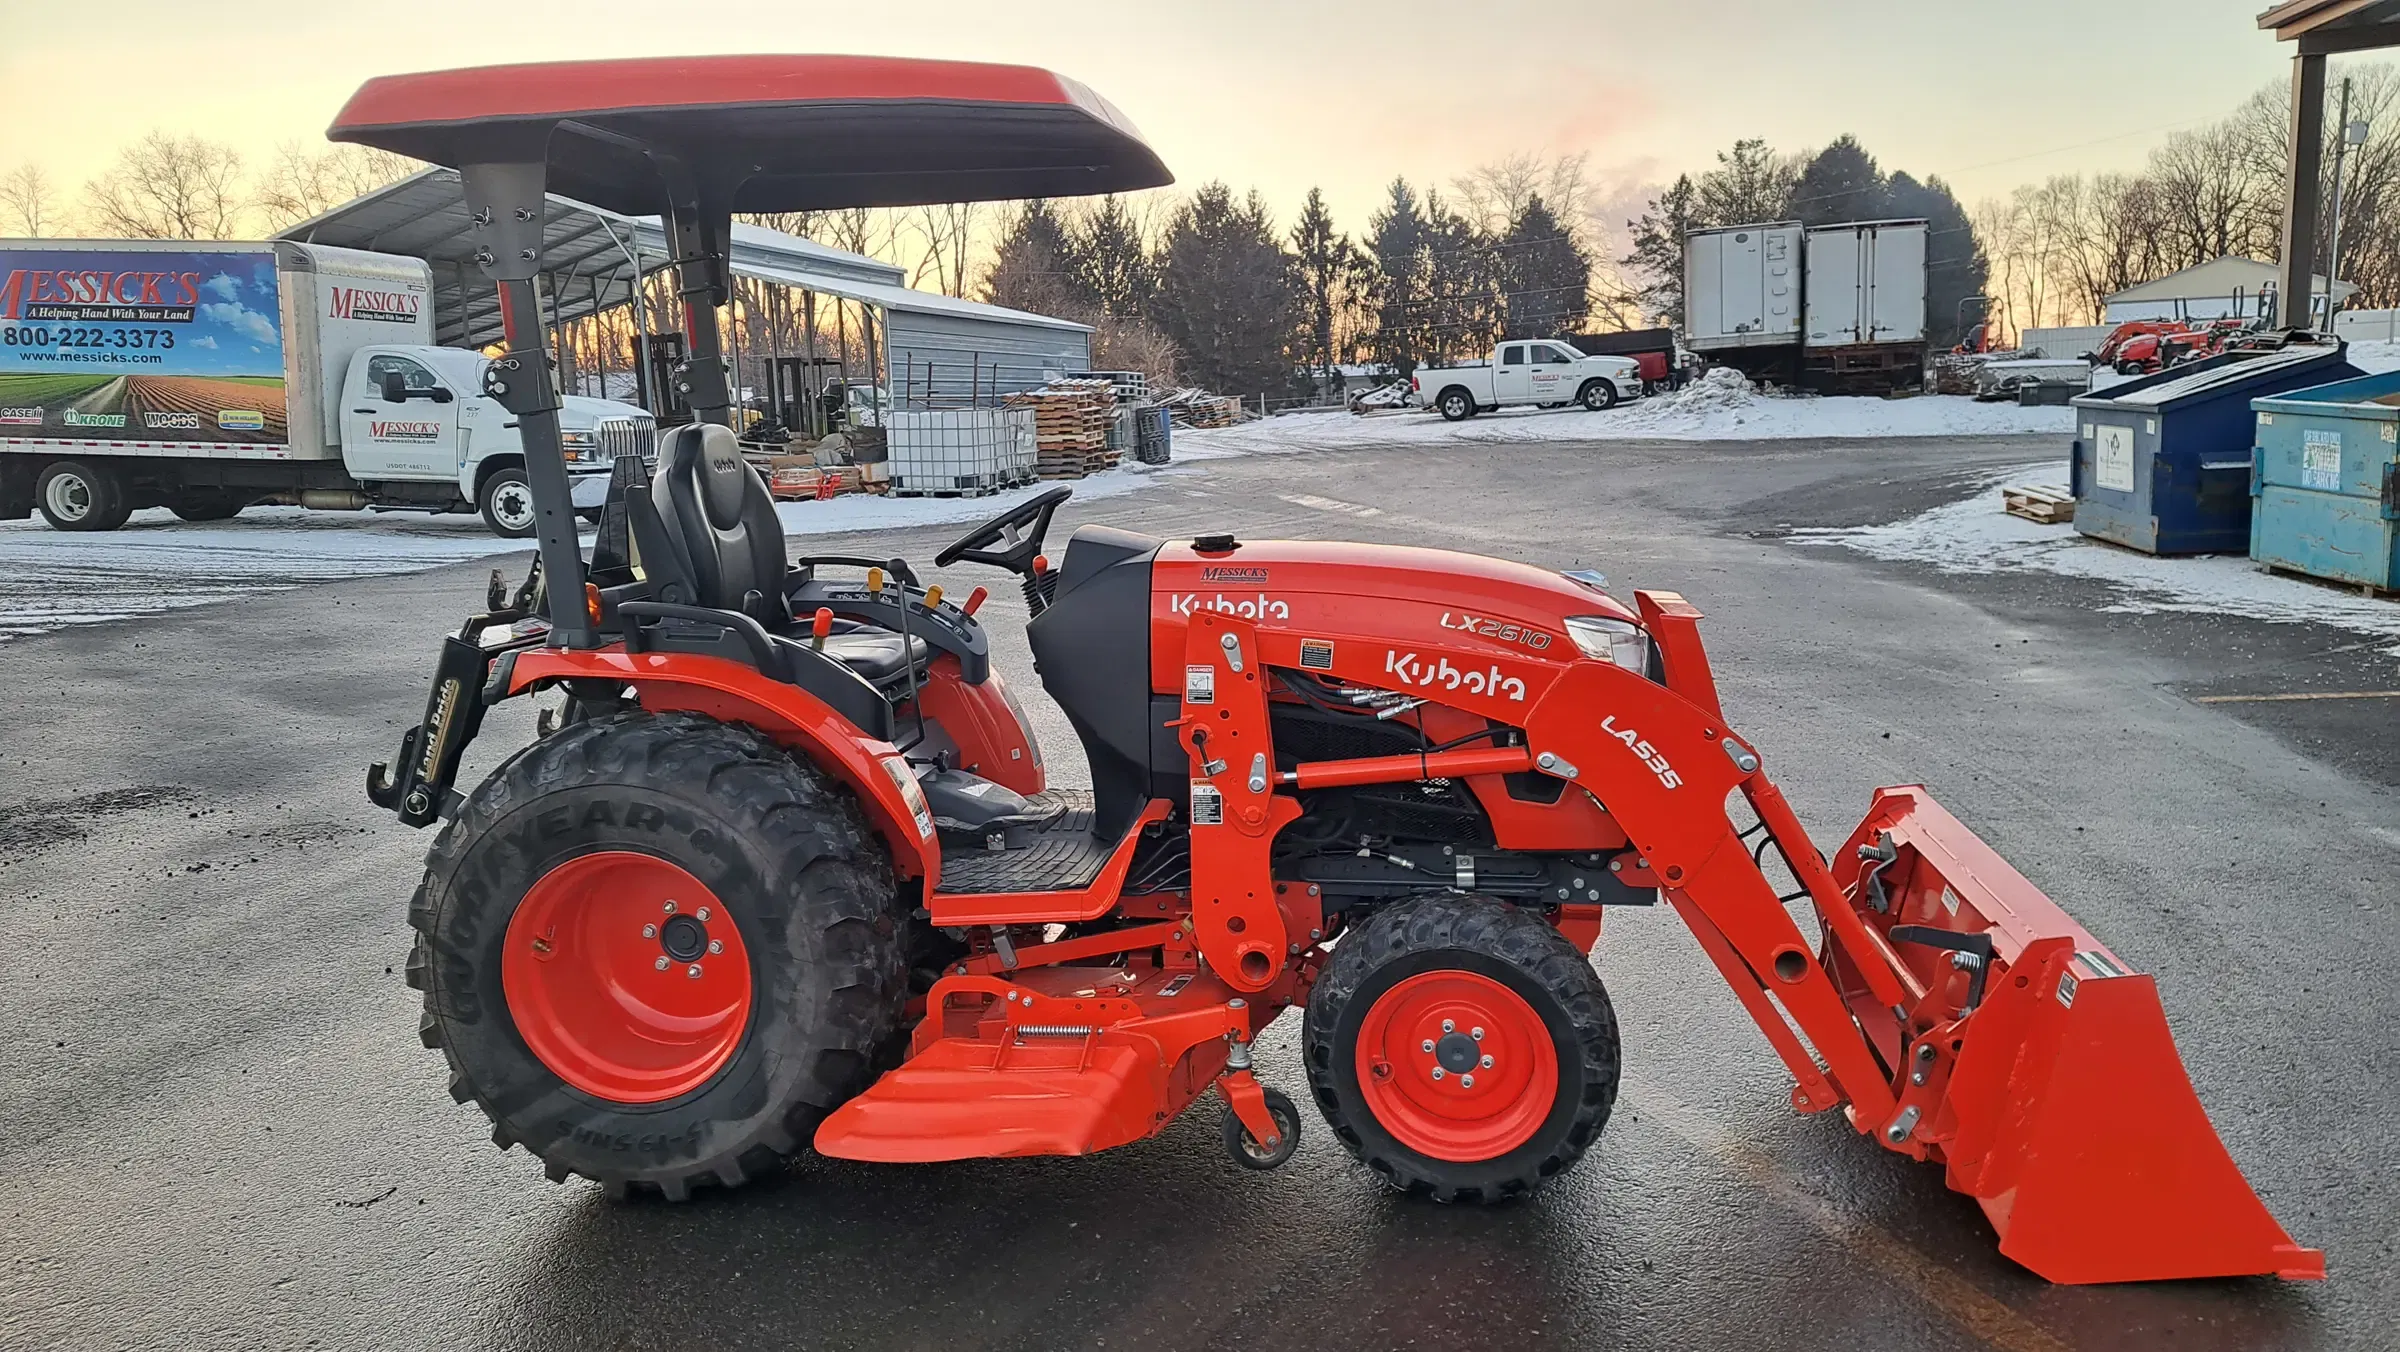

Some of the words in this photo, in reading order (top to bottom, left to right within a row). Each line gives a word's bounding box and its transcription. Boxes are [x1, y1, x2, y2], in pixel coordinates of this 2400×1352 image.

[329, 286, 419, 320] MESSICK'S
[28, 308, 36, 317] A
[39, 308, 79, 320] Helping
[81, 309, 109, 318] Hand
[112, 309, 135, 318] With
[138, 309, 161, 319] Your
[163, 310, 190, 320] Land
[3, 327, 175, 349] 800-222-3373
[19, 352, 163, 364] www.messicks.com
[2, 408, 31, 418] CASE
[80, 415, 126, 426] KRONE
[145, 413, 198, 428] WOODS
[368, 421, 440, 437] MESSICK'S
[1201, 567, 1268, 580] MESSICK'S
[1440, 612, 1552, 650] LX2610
[1386, 650, 1526, 701] Kubota
[416, 731, 437, 777] Land
[431, 679, 453, 728] Pride
[1601, 714, 1684, 789] LA535
